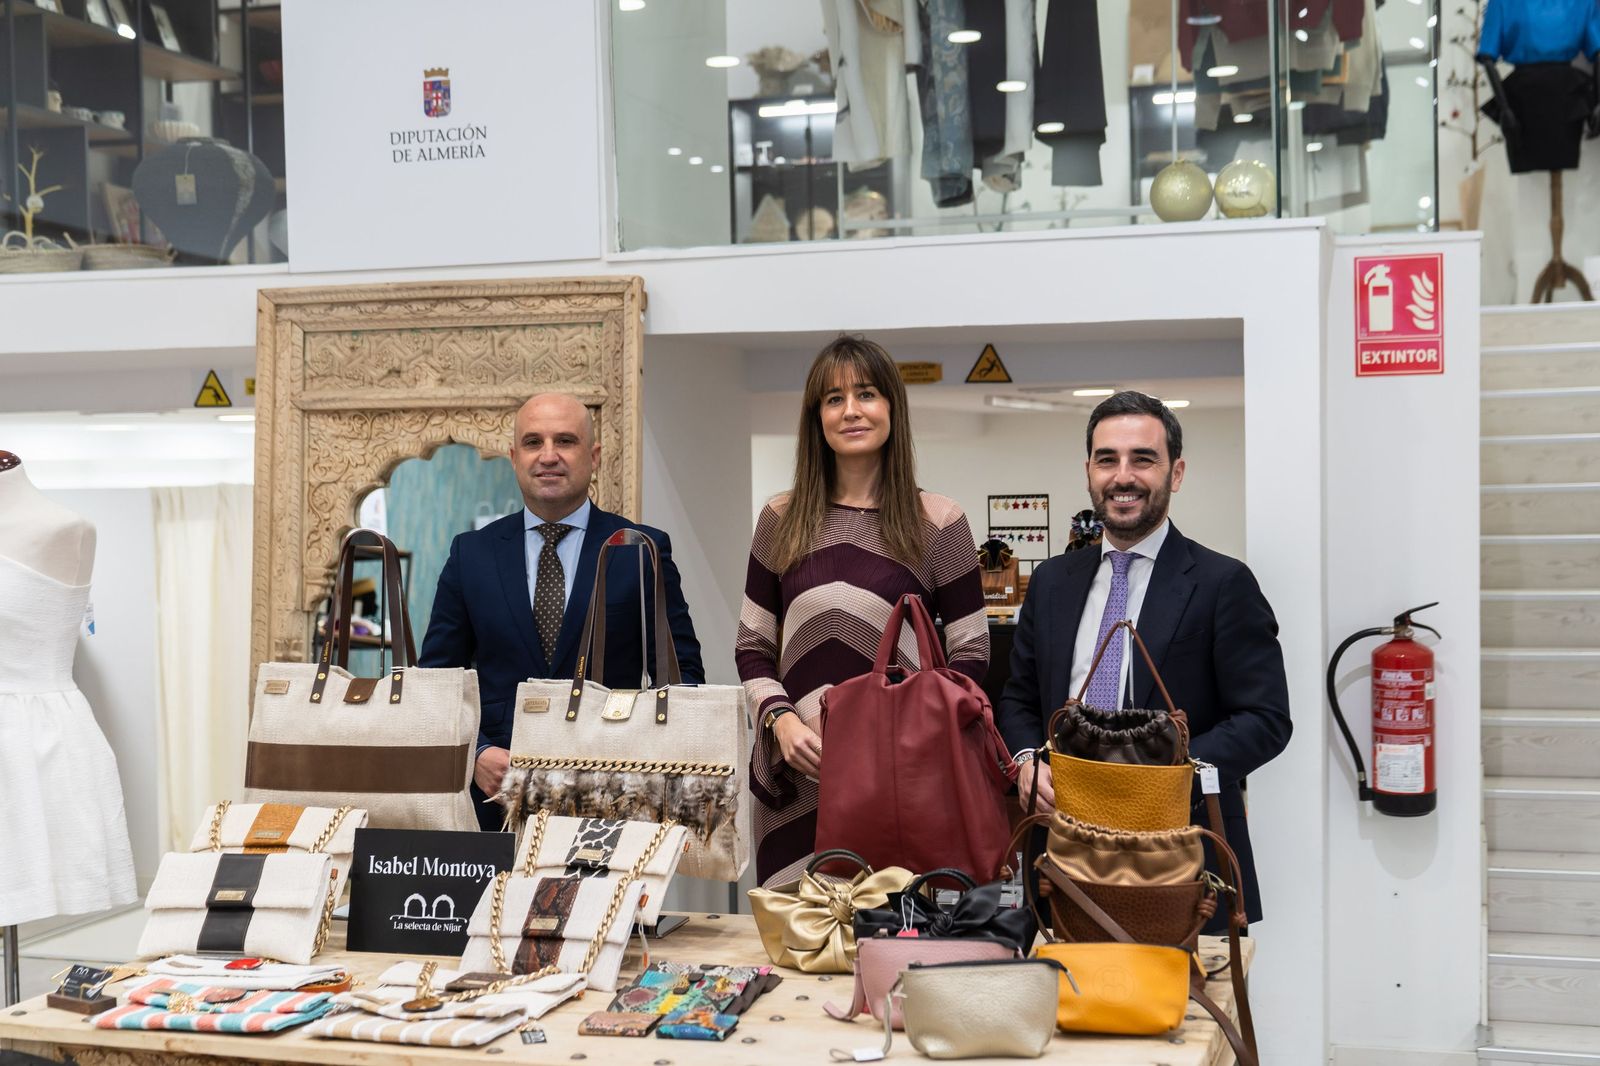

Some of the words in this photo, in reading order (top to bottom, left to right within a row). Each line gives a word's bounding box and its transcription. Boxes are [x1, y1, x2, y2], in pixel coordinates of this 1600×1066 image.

[390, 123, 487, 146] DIPUTACIÓN
[392, 149, 413, 163] DE
[417, 141, 486, 162] ALMERÍA
[1361, 348, 1438, 365] EXTINTOR
[368, 854, 418, 876] Isabel
[422, 856, 497, 883] Montoya
[393, 921, 403, 930] La
[404, 922, 431, 931] selecta
[431, 922, 442, 932] de
